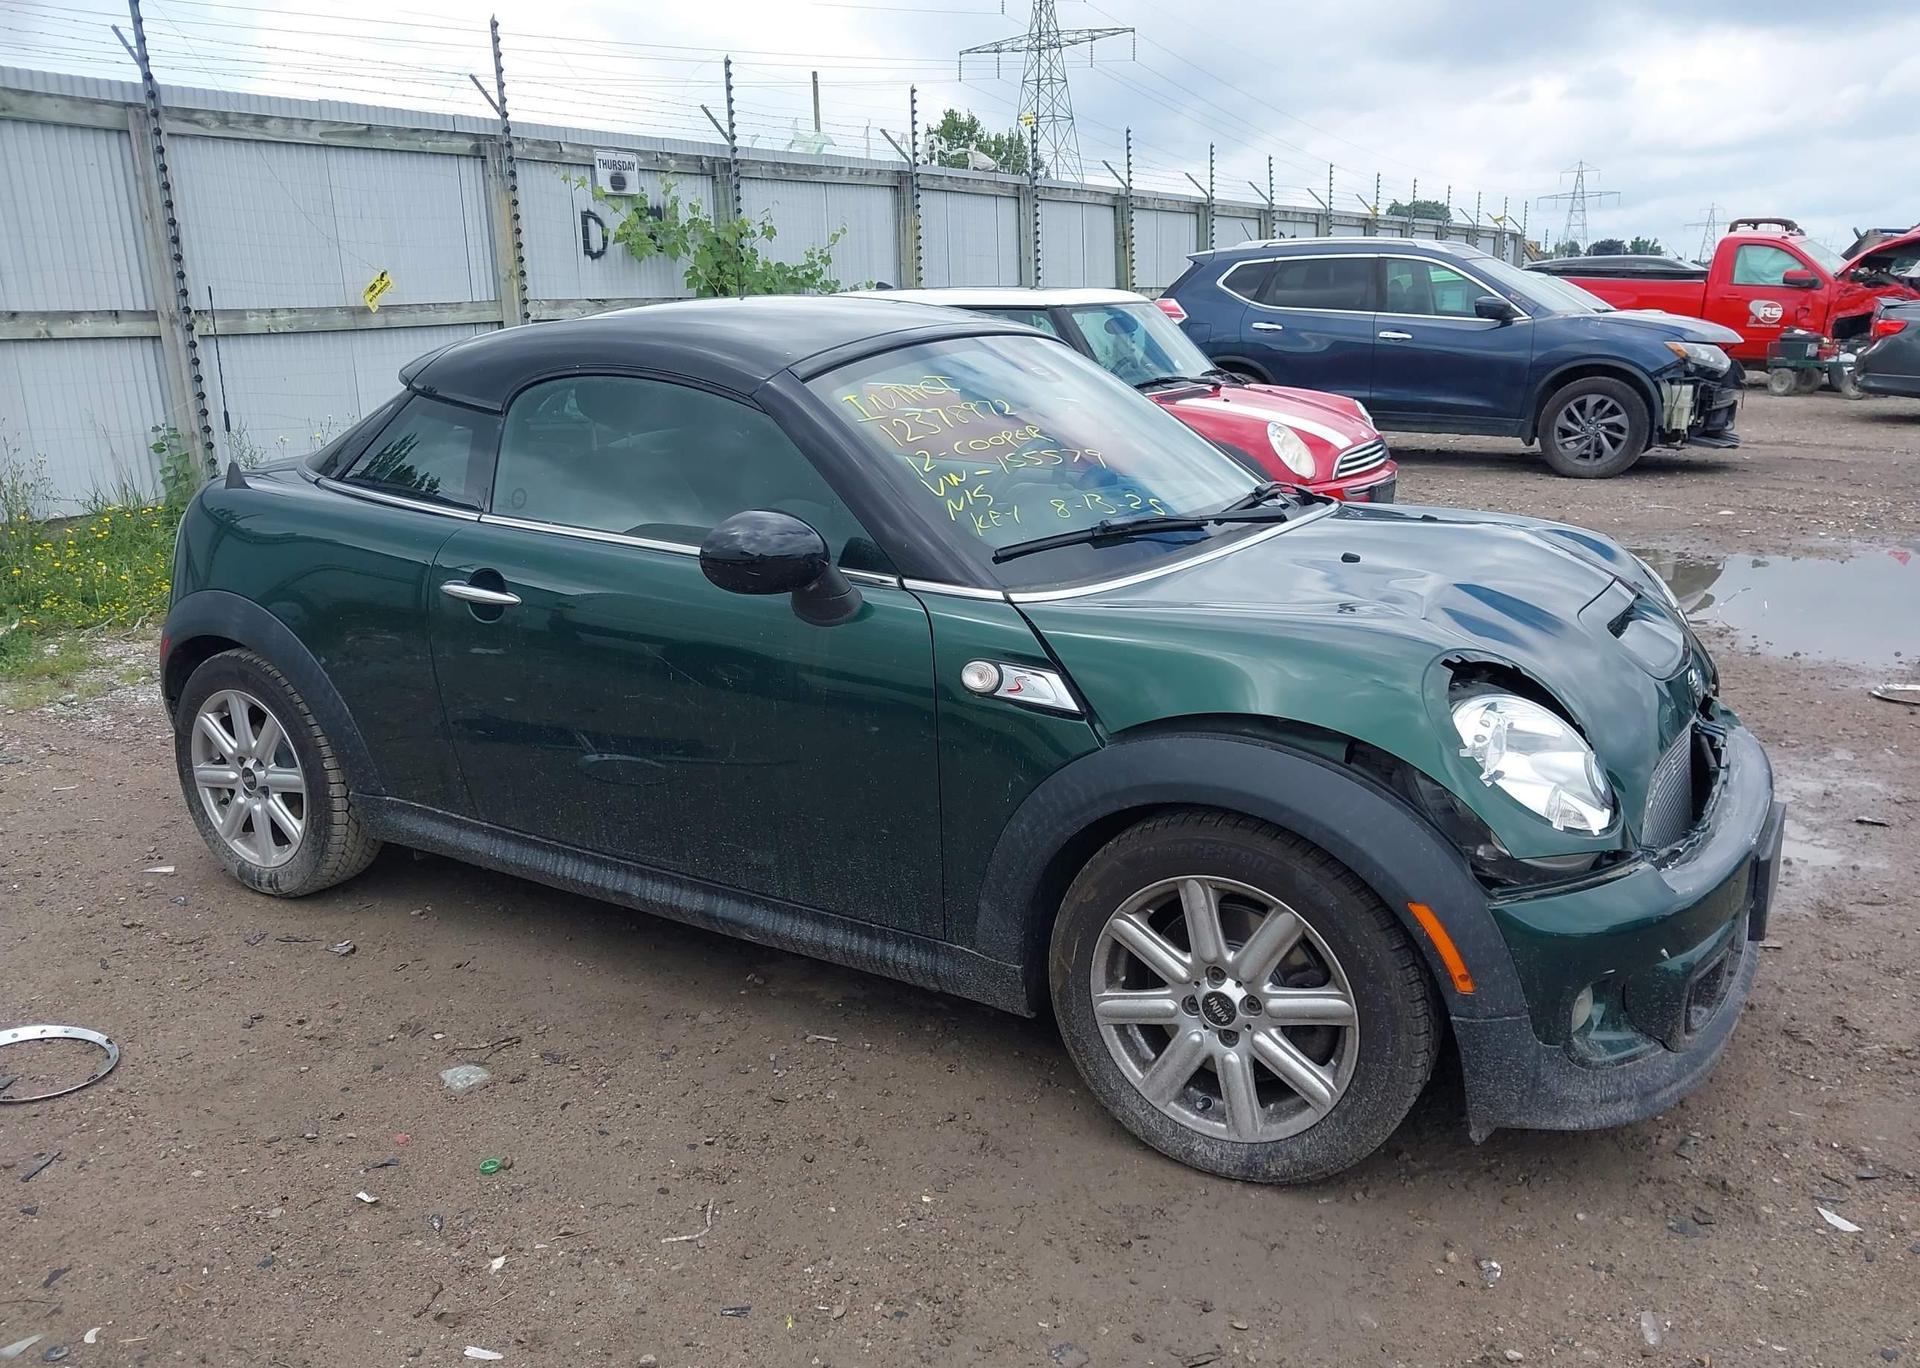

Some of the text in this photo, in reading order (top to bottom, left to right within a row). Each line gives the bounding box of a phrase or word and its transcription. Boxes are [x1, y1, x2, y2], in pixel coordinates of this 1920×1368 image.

[597, 159, 636, 172] THURSDAY
[580, 207, 609, 260] D
[842, 375, 961, 422] INTACT
[1006, 675, 1031, 694] S
[1207, 997, 1229, 1022] MINI
